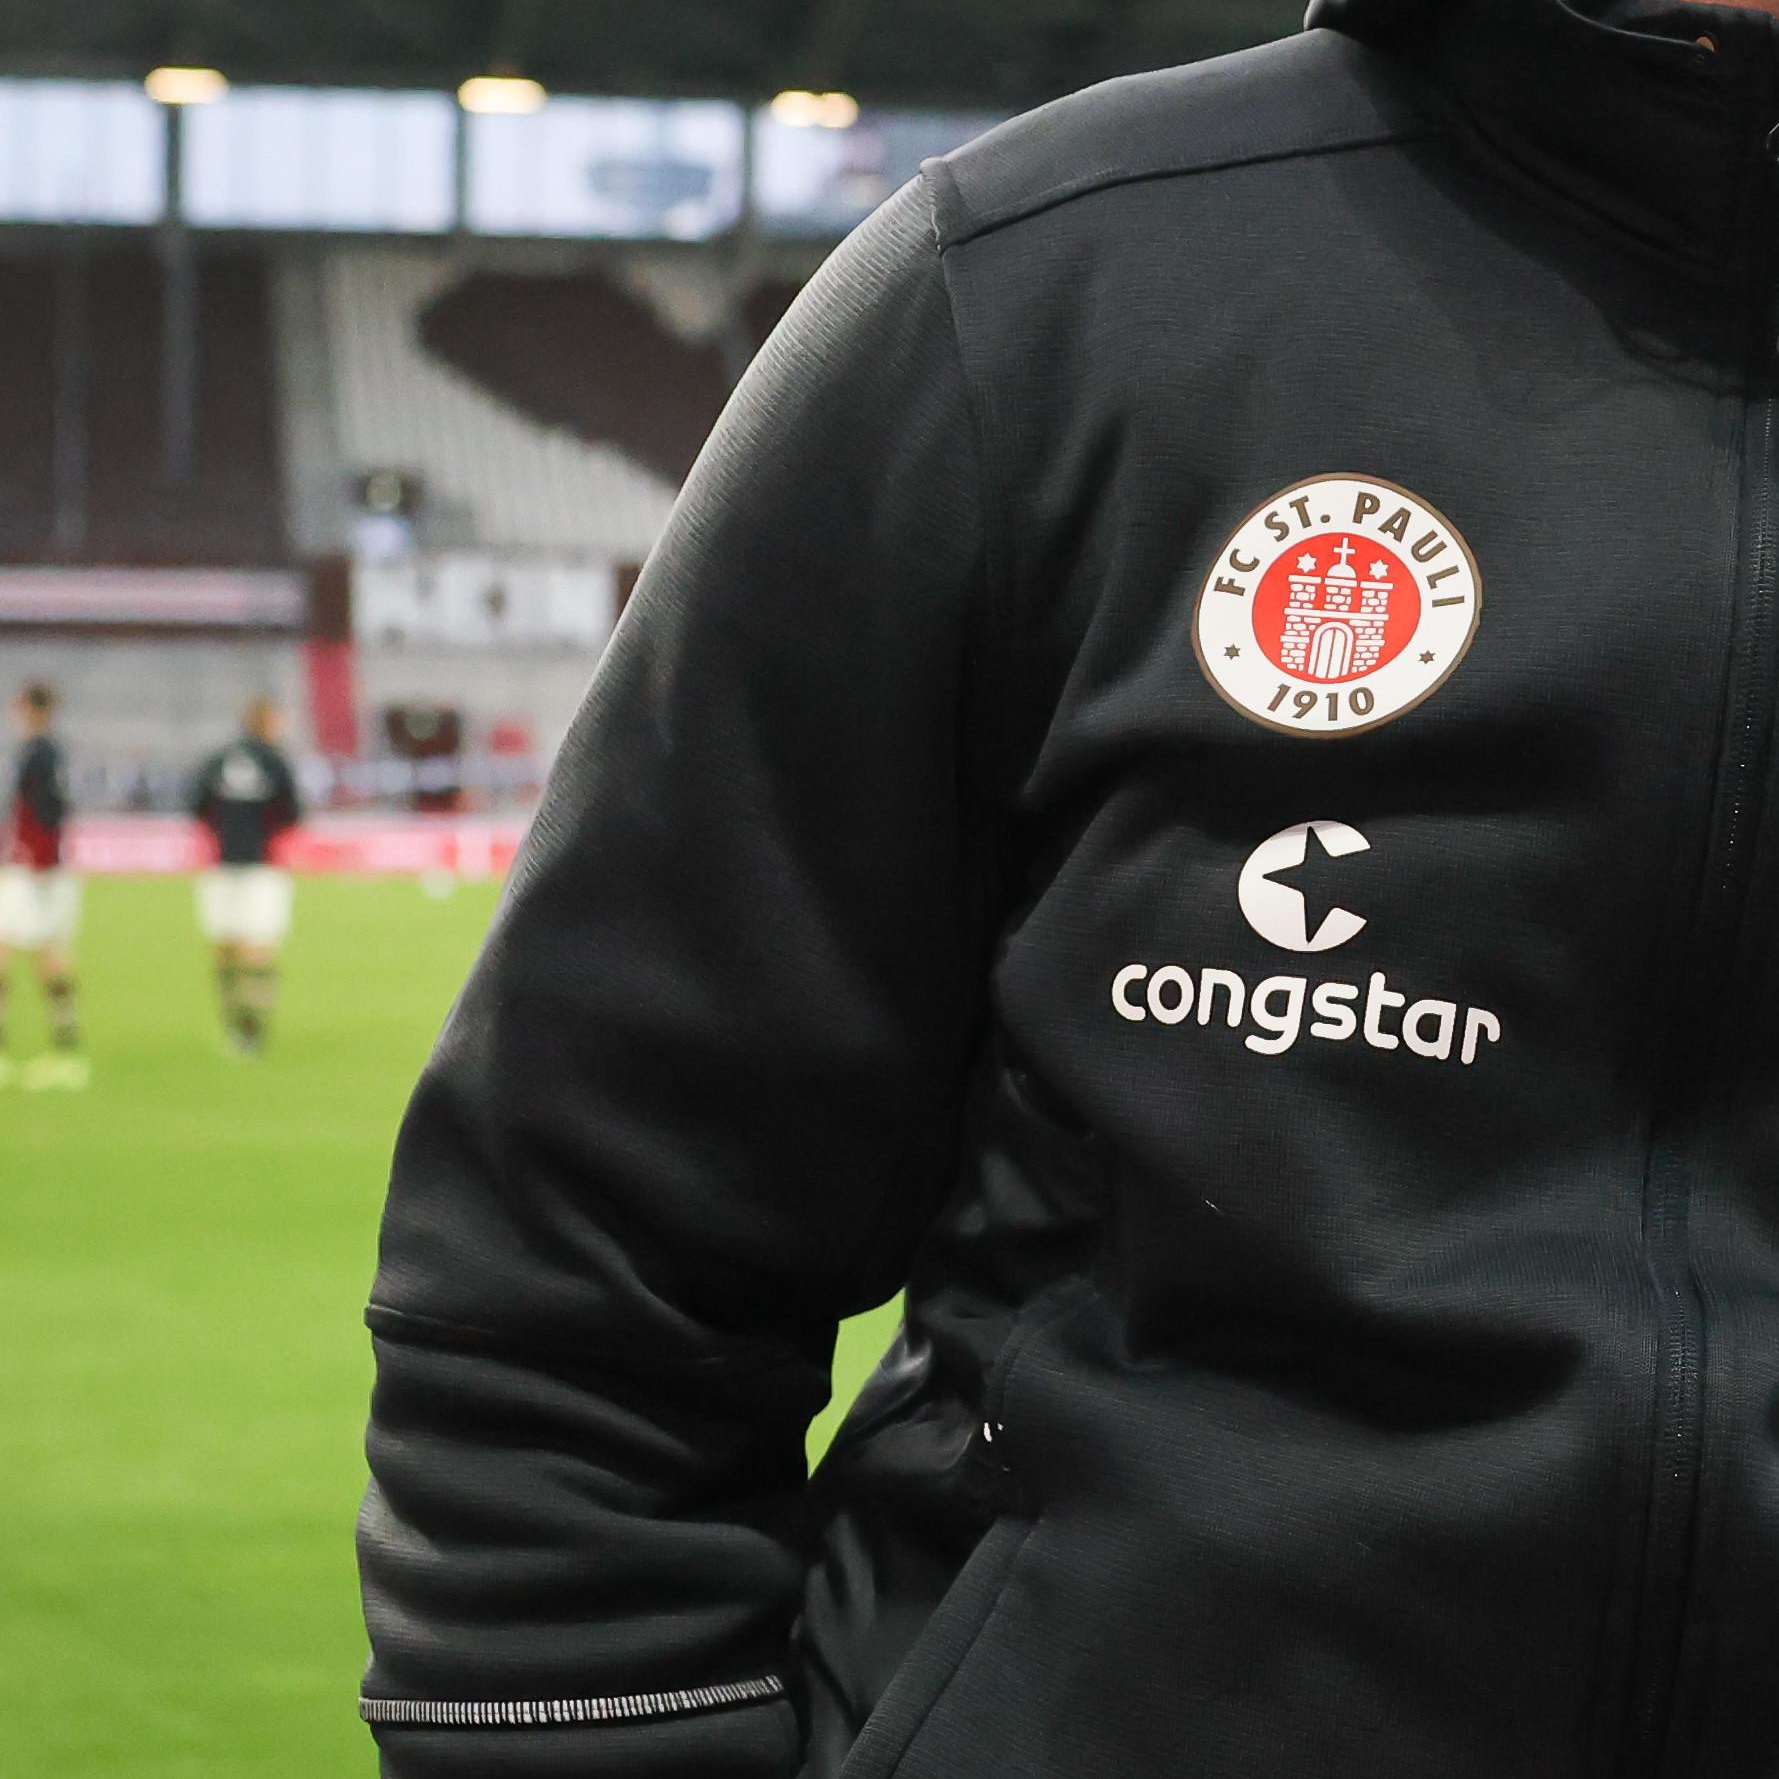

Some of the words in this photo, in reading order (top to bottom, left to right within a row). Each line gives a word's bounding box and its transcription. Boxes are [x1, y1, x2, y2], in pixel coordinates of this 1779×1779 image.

[1213, 548, 1261, 597] FC
[1263, 495, 1331, 543] ST.
[1352, 491, 1465, 608] PAULI
[1267, 683, 1375, 722] 1910
[1111, 962, 1501, 1065] congstar
